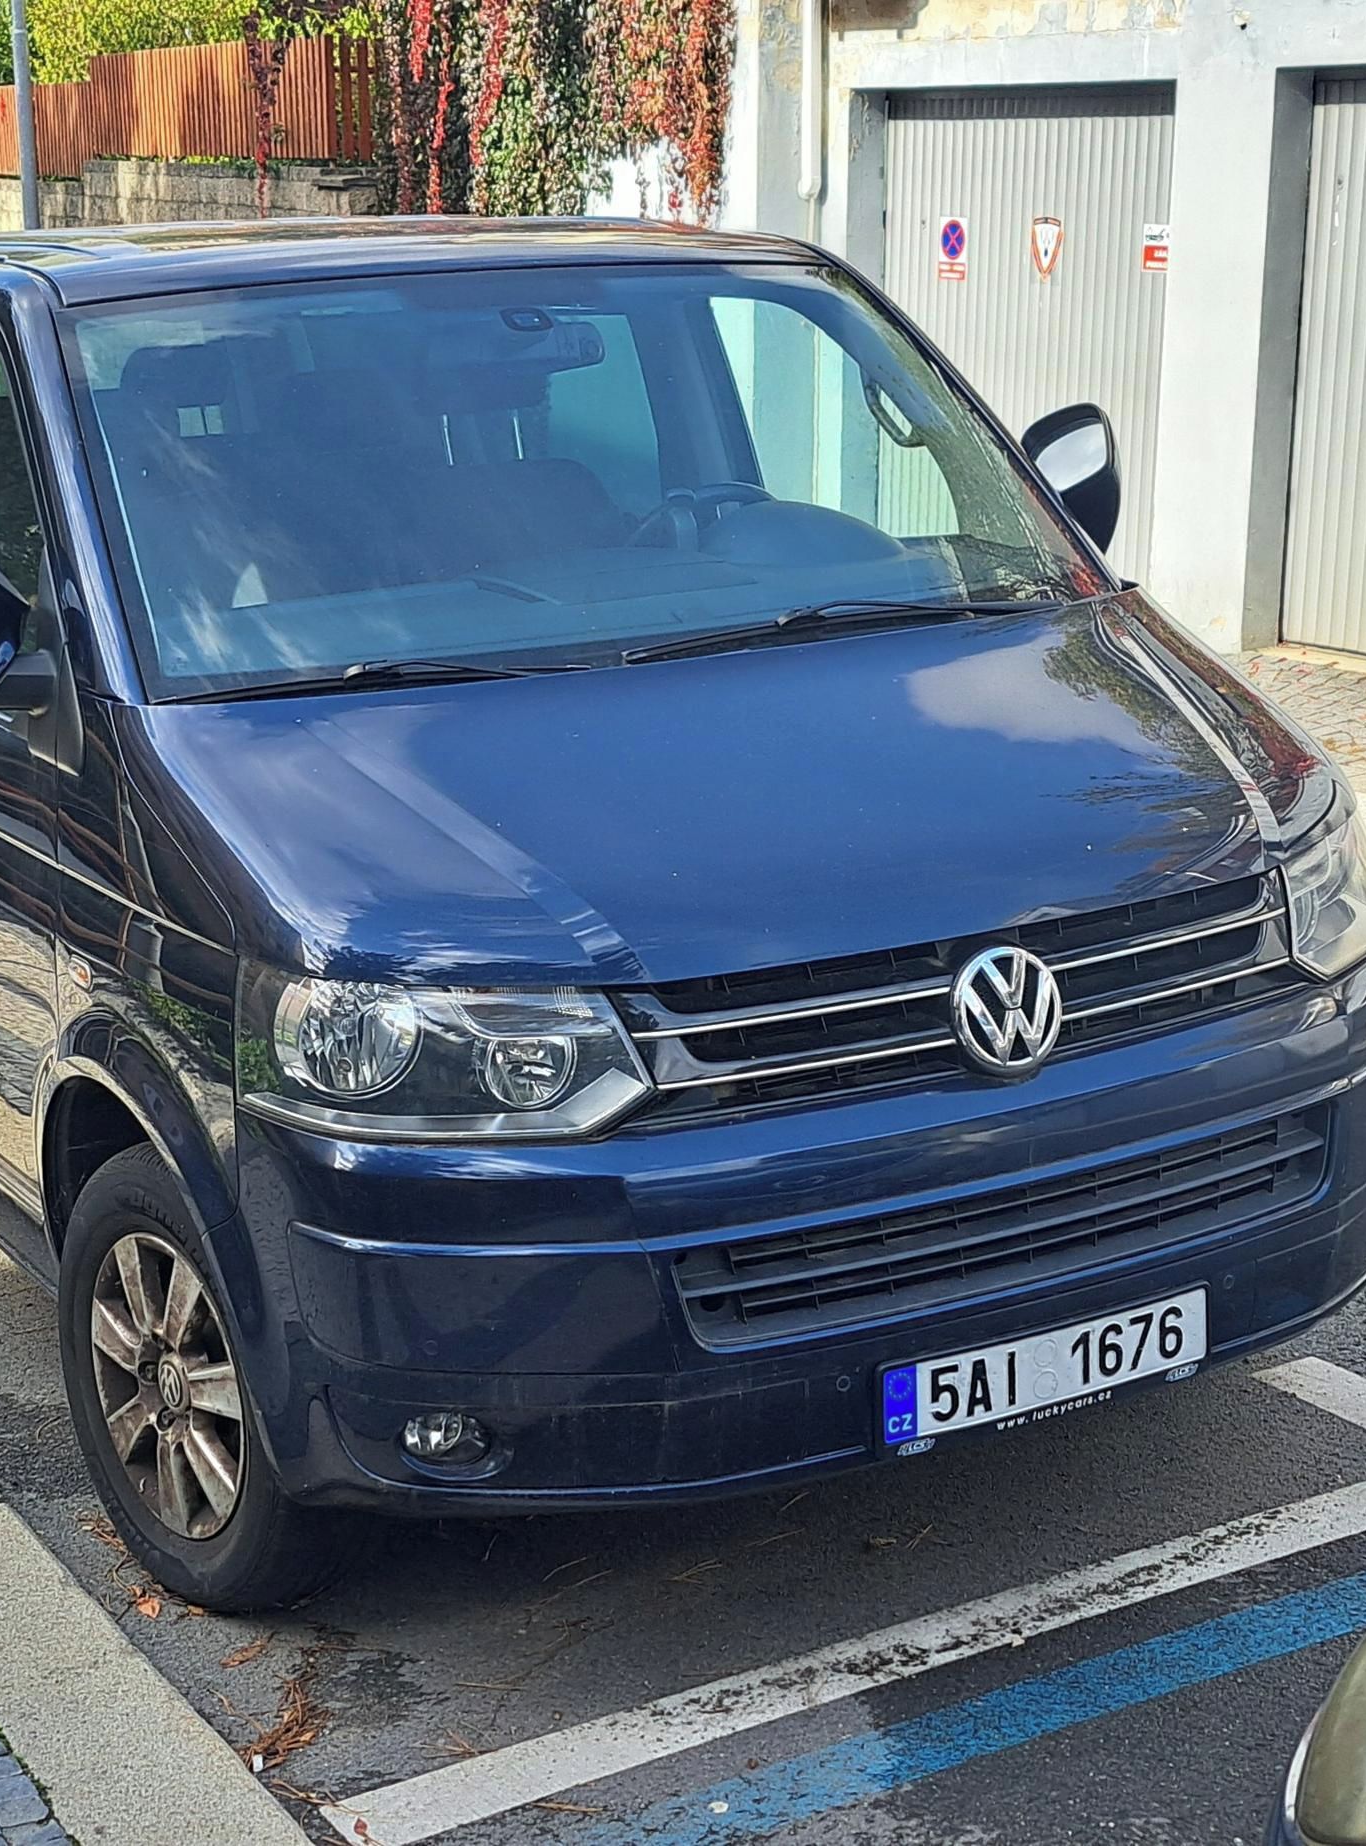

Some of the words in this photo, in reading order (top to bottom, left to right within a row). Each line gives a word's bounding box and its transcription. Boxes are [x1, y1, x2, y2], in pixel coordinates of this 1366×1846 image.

[929, 1350, 1017, 1423] 5AI
[1071, 1305, 1184, 1386] 1676
[887, 1412, 913, 1434] CZ
